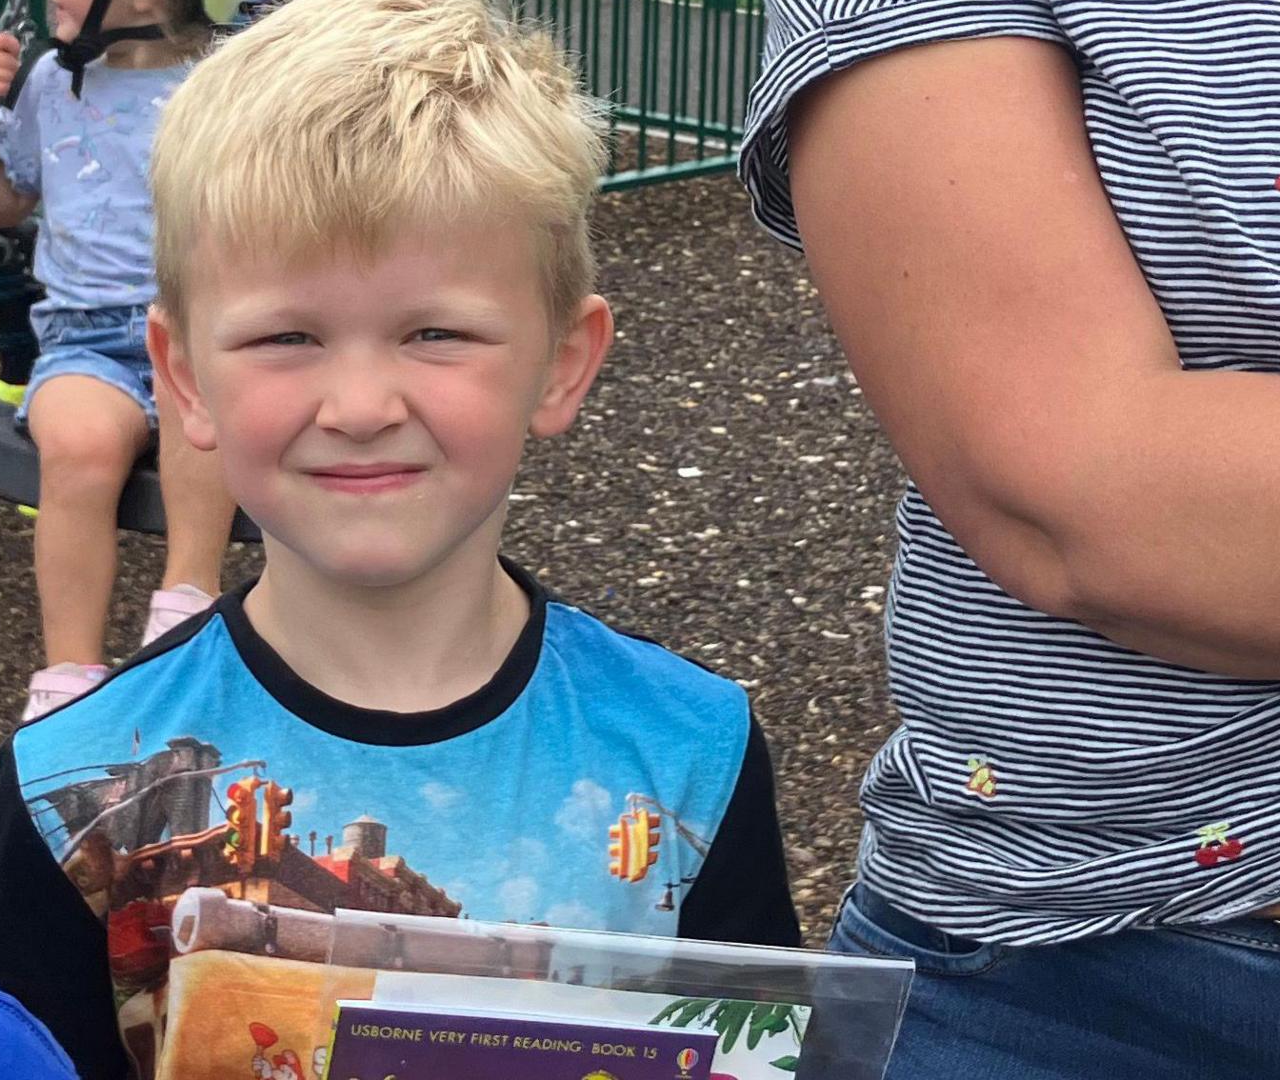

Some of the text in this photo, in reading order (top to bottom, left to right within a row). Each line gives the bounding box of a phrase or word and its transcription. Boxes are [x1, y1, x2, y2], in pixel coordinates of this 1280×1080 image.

[350, 1023, 423, 1041] USBORNE
[429, 1030, 466, 1044] VERY
[471, 1032, 508, 1047] FIRST
[591, 1043, 635, 1057] BOOK
[643, 1047, 657, 1059] 15
